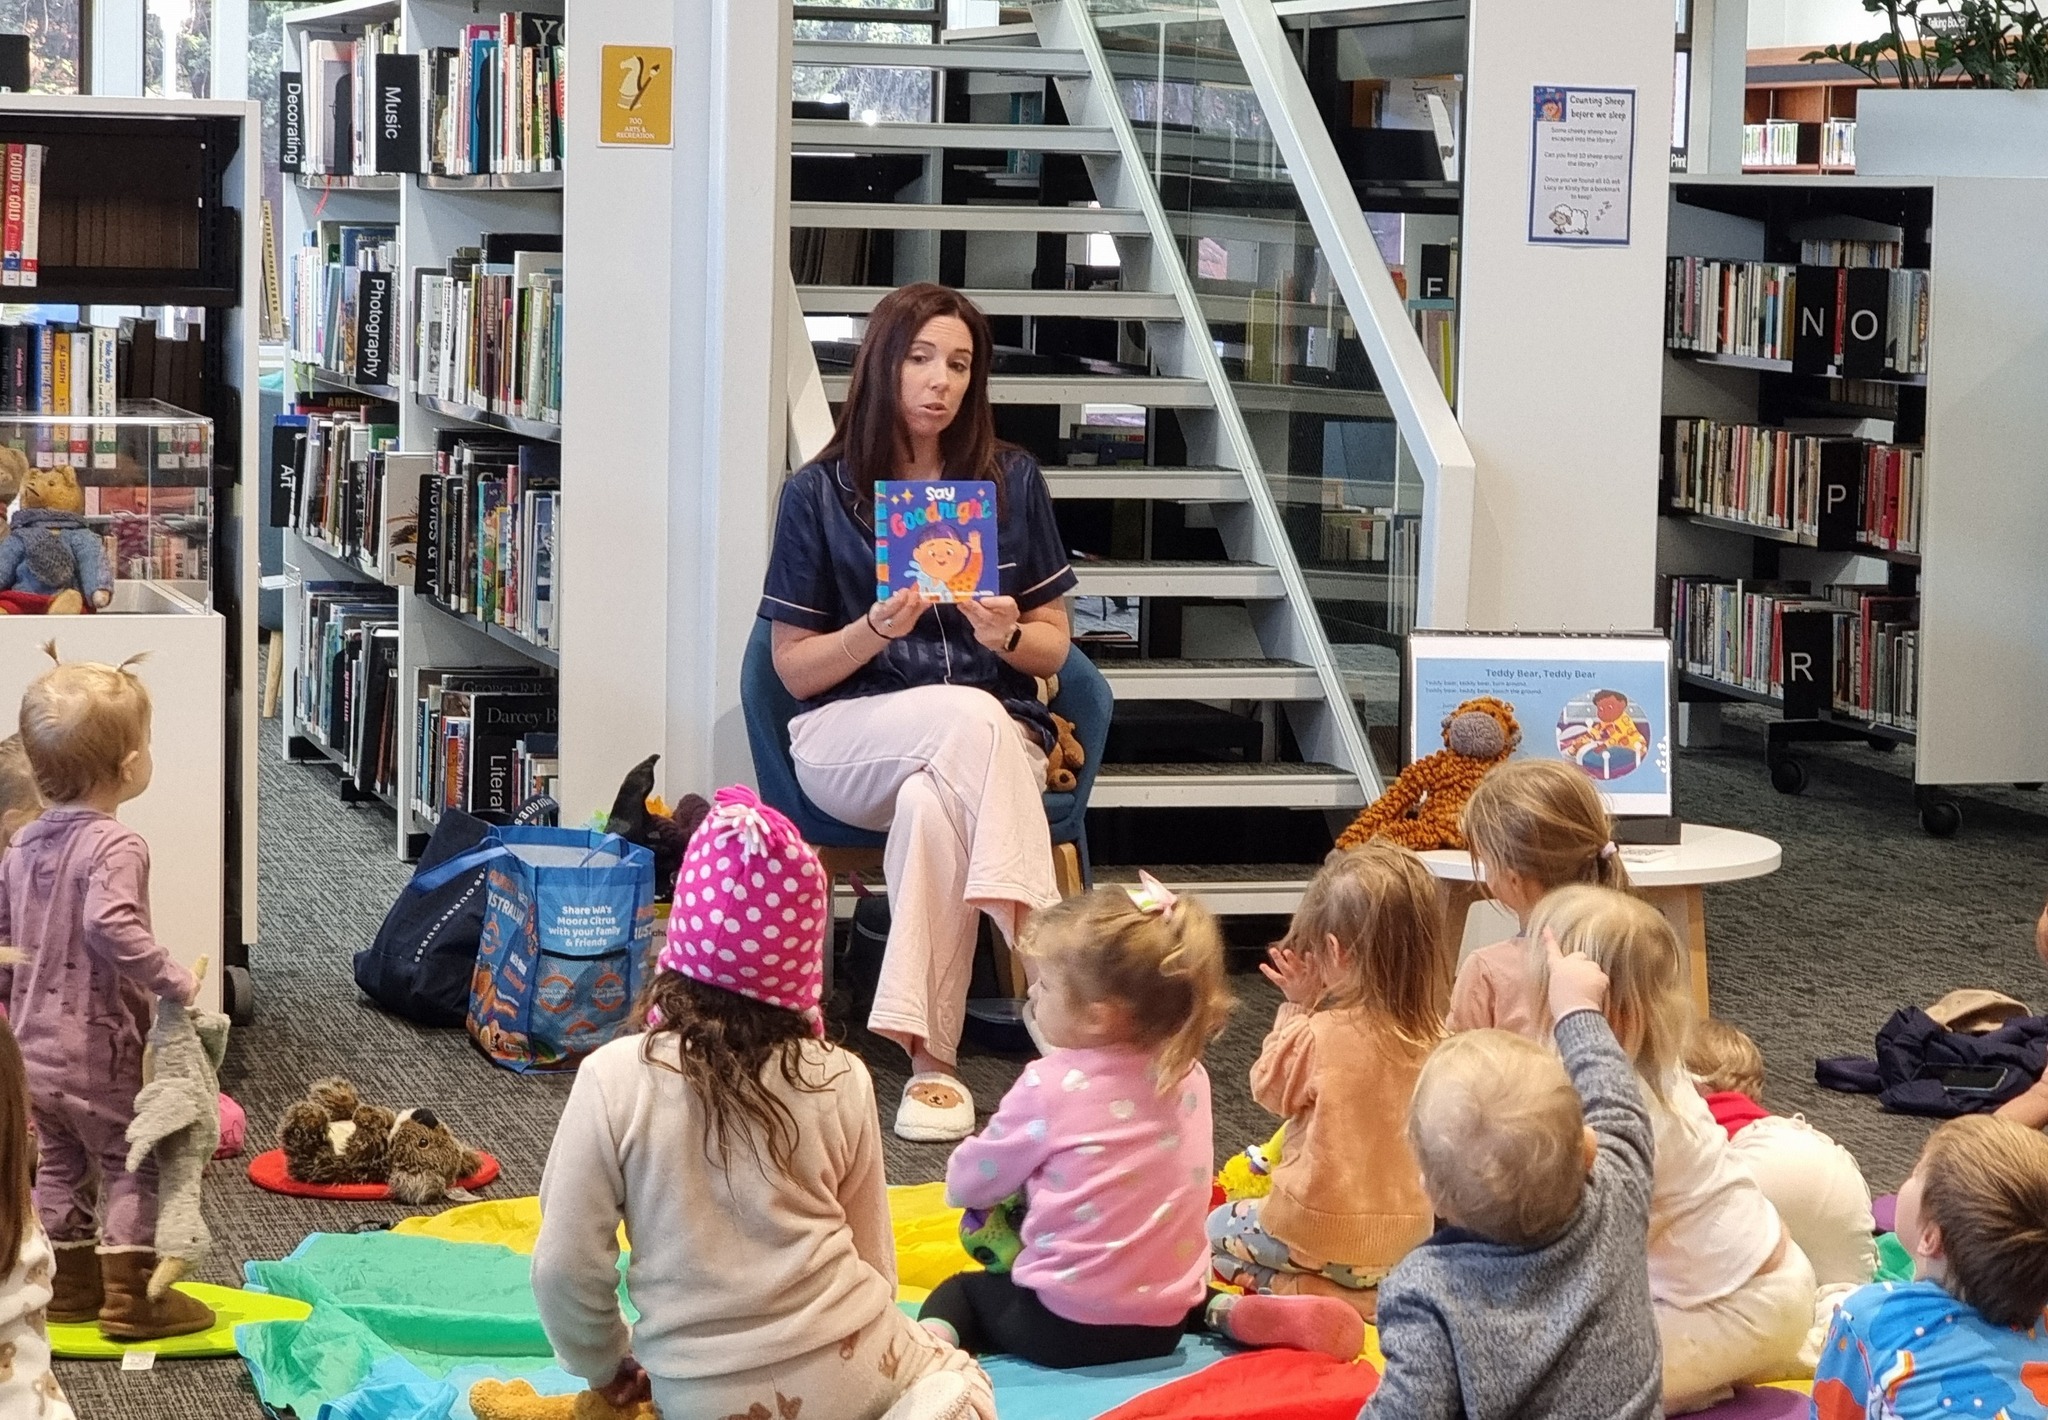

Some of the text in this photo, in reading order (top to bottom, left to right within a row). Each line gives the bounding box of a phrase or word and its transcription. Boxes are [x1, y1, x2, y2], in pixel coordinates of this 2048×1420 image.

[385, 86, 402, 139] Music
[1569, 95, 1626, 108] Counting Sheep
[284, 82, 302, 164] Decorating
[1571, 109, 1594, 120] before
[1608, 110, 1627, 122] sleep
[10, 153, 22, 182] GOOD
[1671, 154, 1687, 169] Print
[8, 194, 21, 221] GOLD
[363, 278, 385, 377] Photography
[1801, 306, 1824, 337] N
[1851, 309, 1878, 341] O
[59, 358, 67, 384] SMITH
[103, 340, 113, 383] Wole Soyinka
[281, 464, 295, 488] Art
[925, 486, 955, 502] Say
[1827, 484, 1847, 514] P
[427, 478, 441, 541] Movies
[890, 498, 992, 538] Goodnight
[1485, 669, 1597, 680] Teddy Bear, Teddy Bear
[1790, 652, 1814, 682] R
[487, 707, 540, 728] Darcey
[556, 915, 616, 926] Moora Citrus
[562, 905, 612, 915] Share WA's
[548, 926, 621, 938] with your family
[565, 937, 607, 948] & friends
